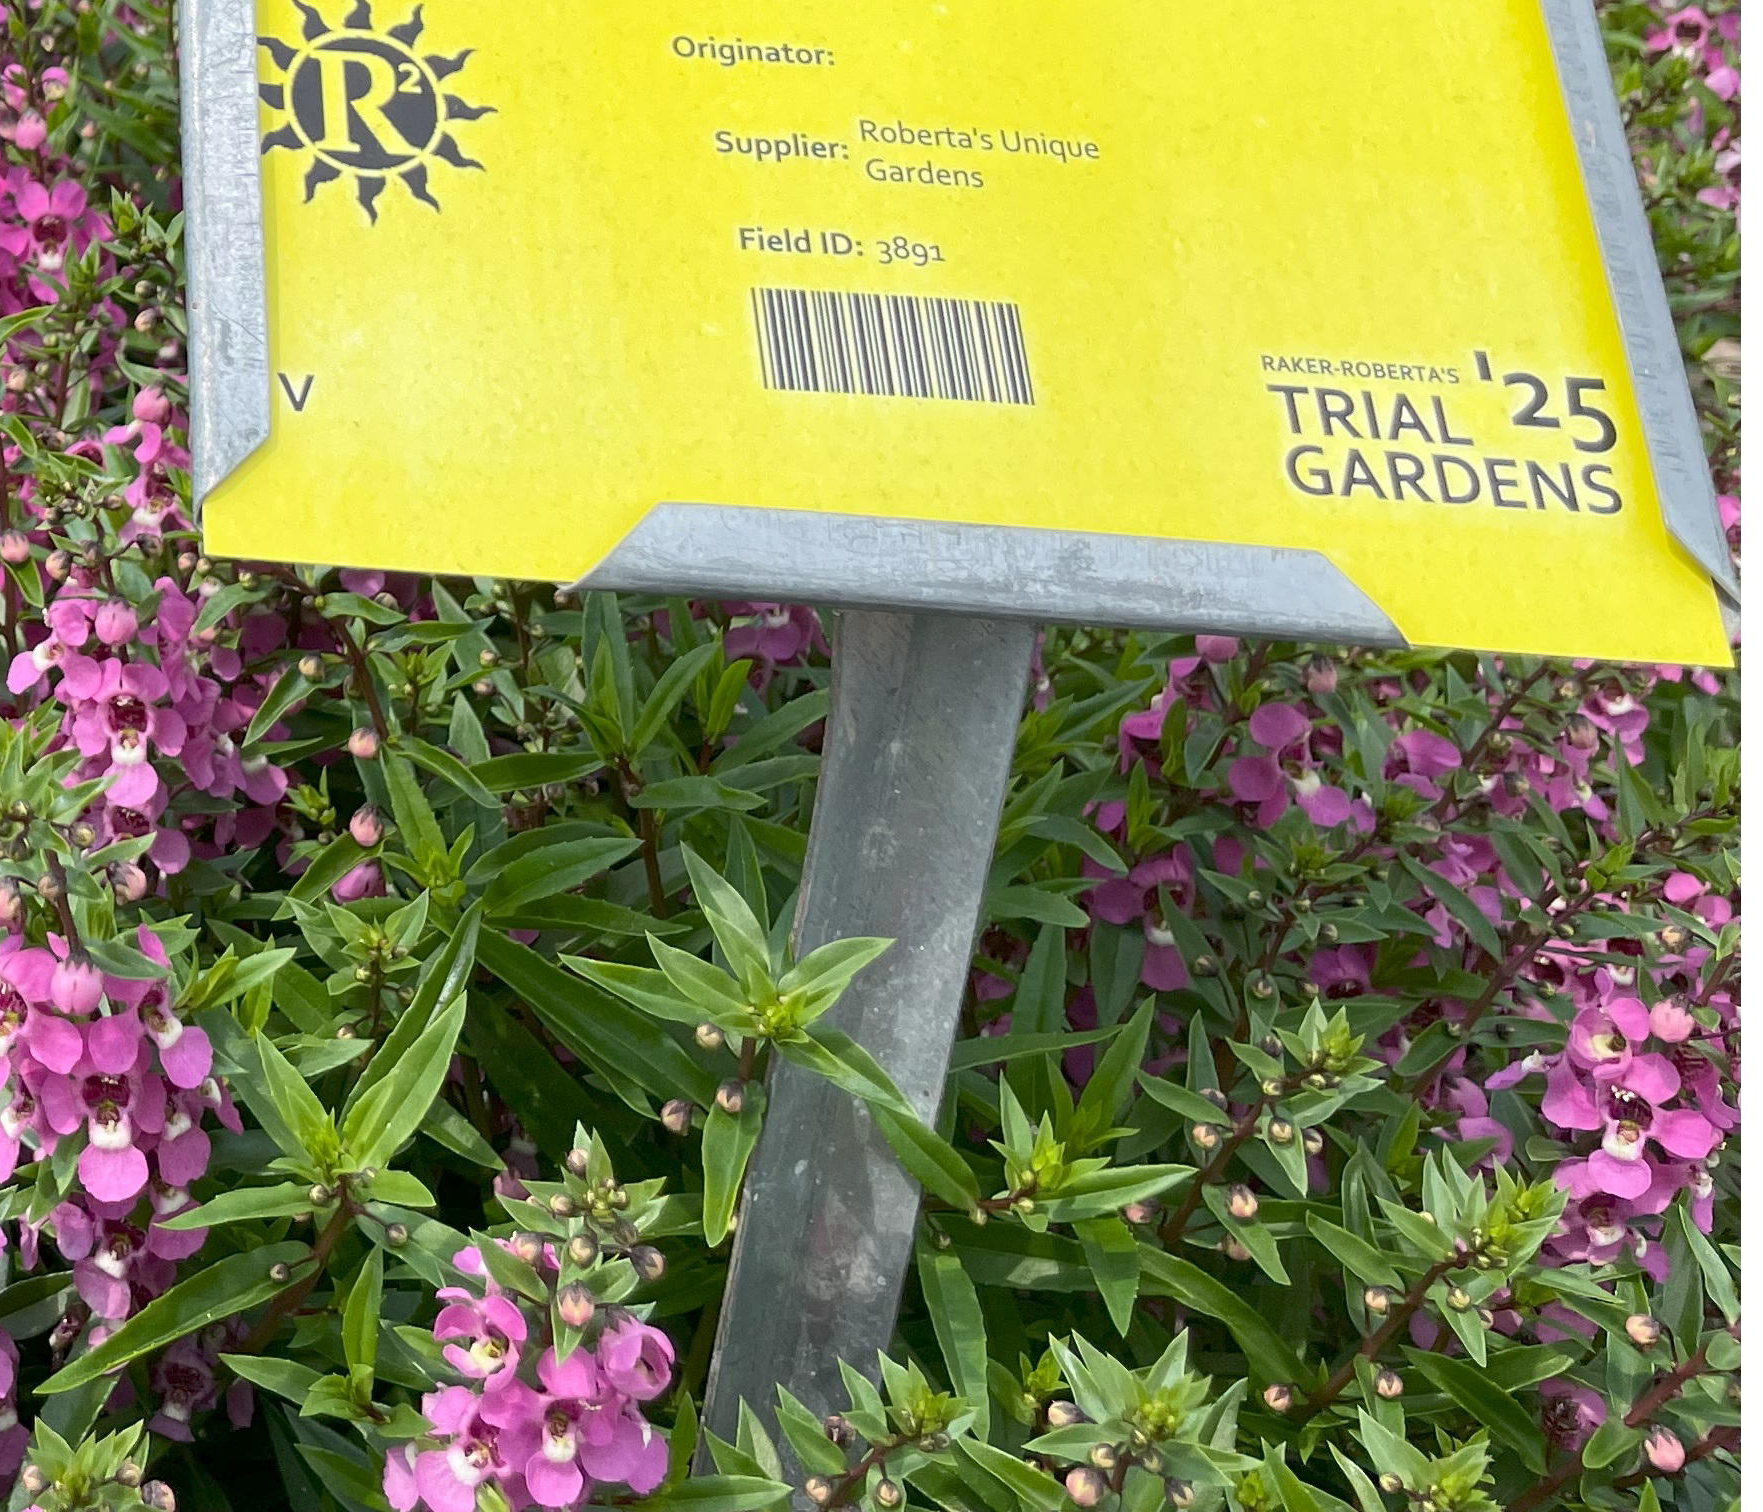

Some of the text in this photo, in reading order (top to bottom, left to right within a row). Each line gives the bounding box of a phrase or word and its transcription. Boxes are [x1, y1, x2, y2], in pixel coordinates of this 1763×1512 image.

[671, 35, 836, 67] Originator:
[715, 119, 1101, 164] Supplier: Roberta's Unique
[865, 158, 985, 189] Gardens
[738, 226, 947, 266] Field ID: 3891
[277, 371, 315, 412] V
[1261, 350, 1618, 454] RAKER-ROBERTA'S '25
[1266, 384, 1474, 447] TRIAL
[1285, 444, 1623, 515] GARDENS
